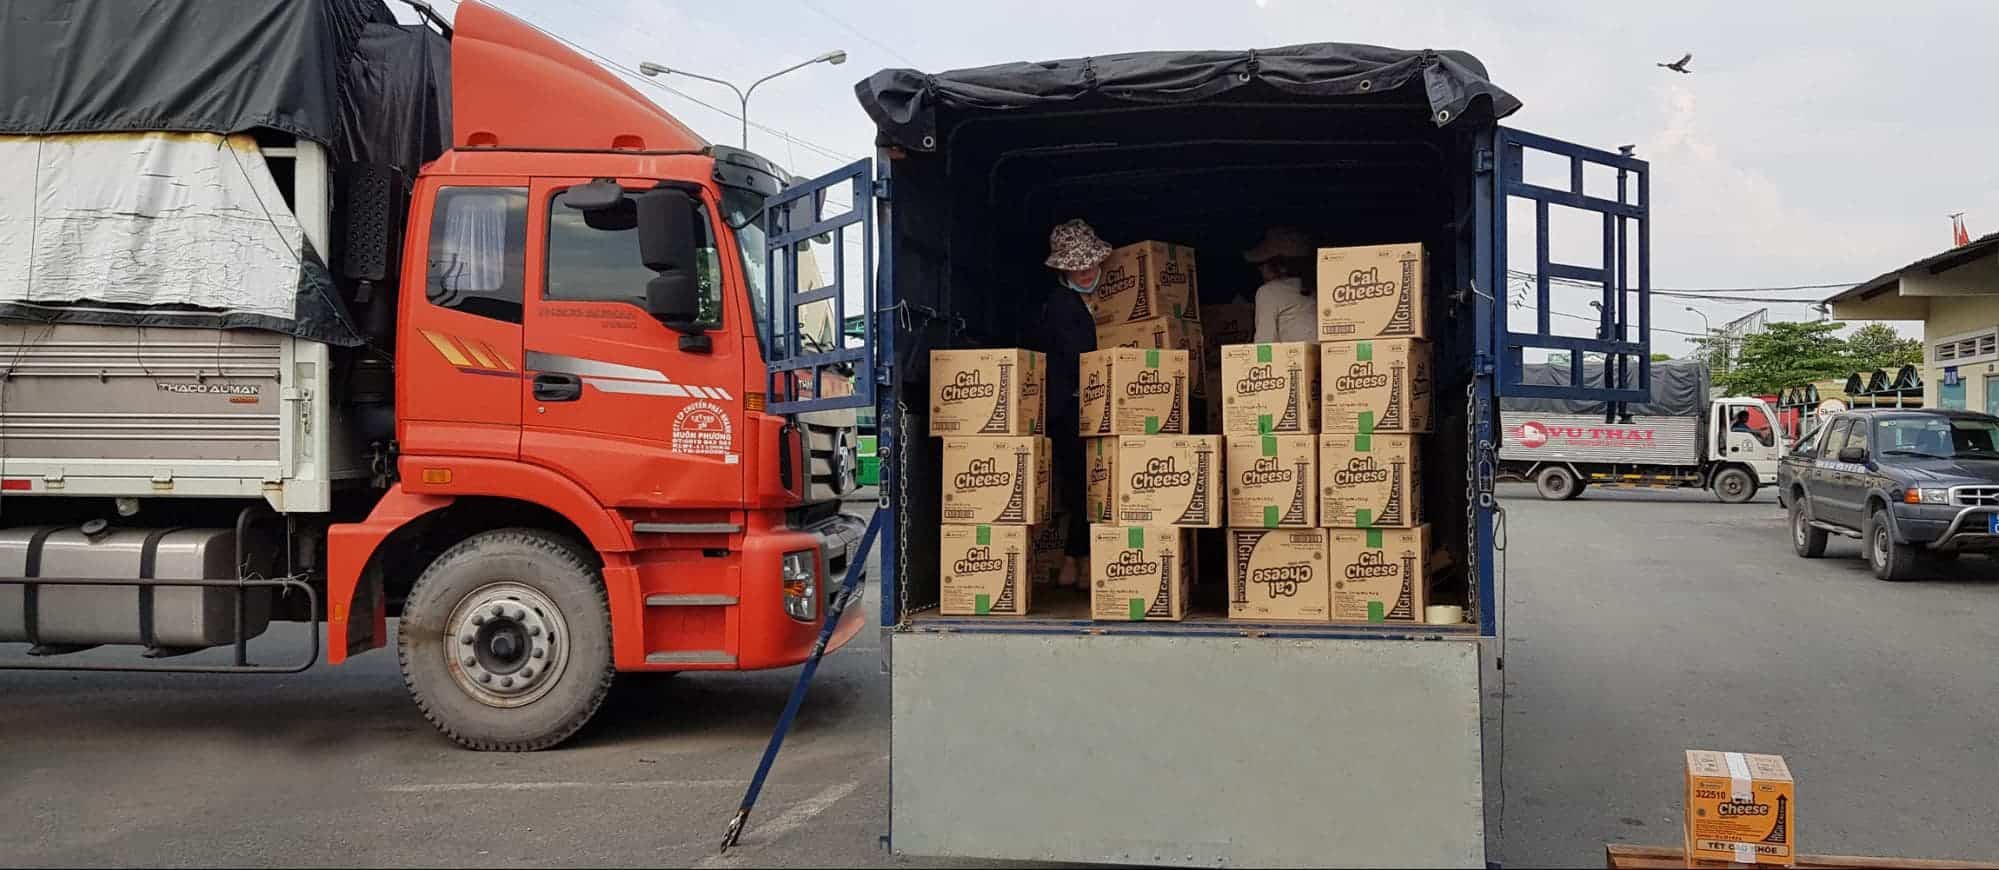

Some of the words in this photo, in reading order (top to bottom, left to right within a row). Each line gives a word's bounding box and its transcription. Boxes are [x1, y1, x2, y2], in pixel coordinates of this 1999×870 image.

[1349, 267, 1378, 286] Cal
[1333, 282, 1394, 303] Cheese
[1385, 305, 1409, 333] HIGH
[1249, 365, 1272, 381] Cal
[1349, 361, 1373, 376] Cal
[956, 370, 981, 386] Cal
[1138, 370, 1159, 384] Cal
[1336, 375, 1387, 391] Cheese
[160, 384, 207, 392] THACO
[209, 385, 259, 394] AUMAN
[942, 383, 994, 401] Cheese
[1127, 383, 1171, 396] Cheese
[1237, 377, 1285, 394] Cheese
[969, 457, 995, 474] Cal
[1147, 456, 1175, 474] Cal
[1255, 457, 1278, 472] Cal
[1348, 456, 1372, 471] Cal
[955, 471, 1010, 489] Cheese
[1131, 471, 1191, 489] Cheese
[1242, 469, 1292, 485] Cheese
[1334, 469, 1387, 485] Cheese
[1181, 499, 1204, 522] HIGH
[967, 547, 991, 560] Cal
[1239, 534, 1261, 560] HIGH
[1119, 550, 1144, 564] Cal
[1358, 551, 1383, 566] Cal
[954, 559, 1002, 574] Cheese
[1106, 563, 1157, 577] Cheese
[1253, 566, 1312, 583] Cheese
[1345, 564, 1399, 579] Cheese
[1269, 581, 1297, 599] Cal
[1696, 790, 1726, 800] 322510
[1718, 803, 1768, 816] Cheese
